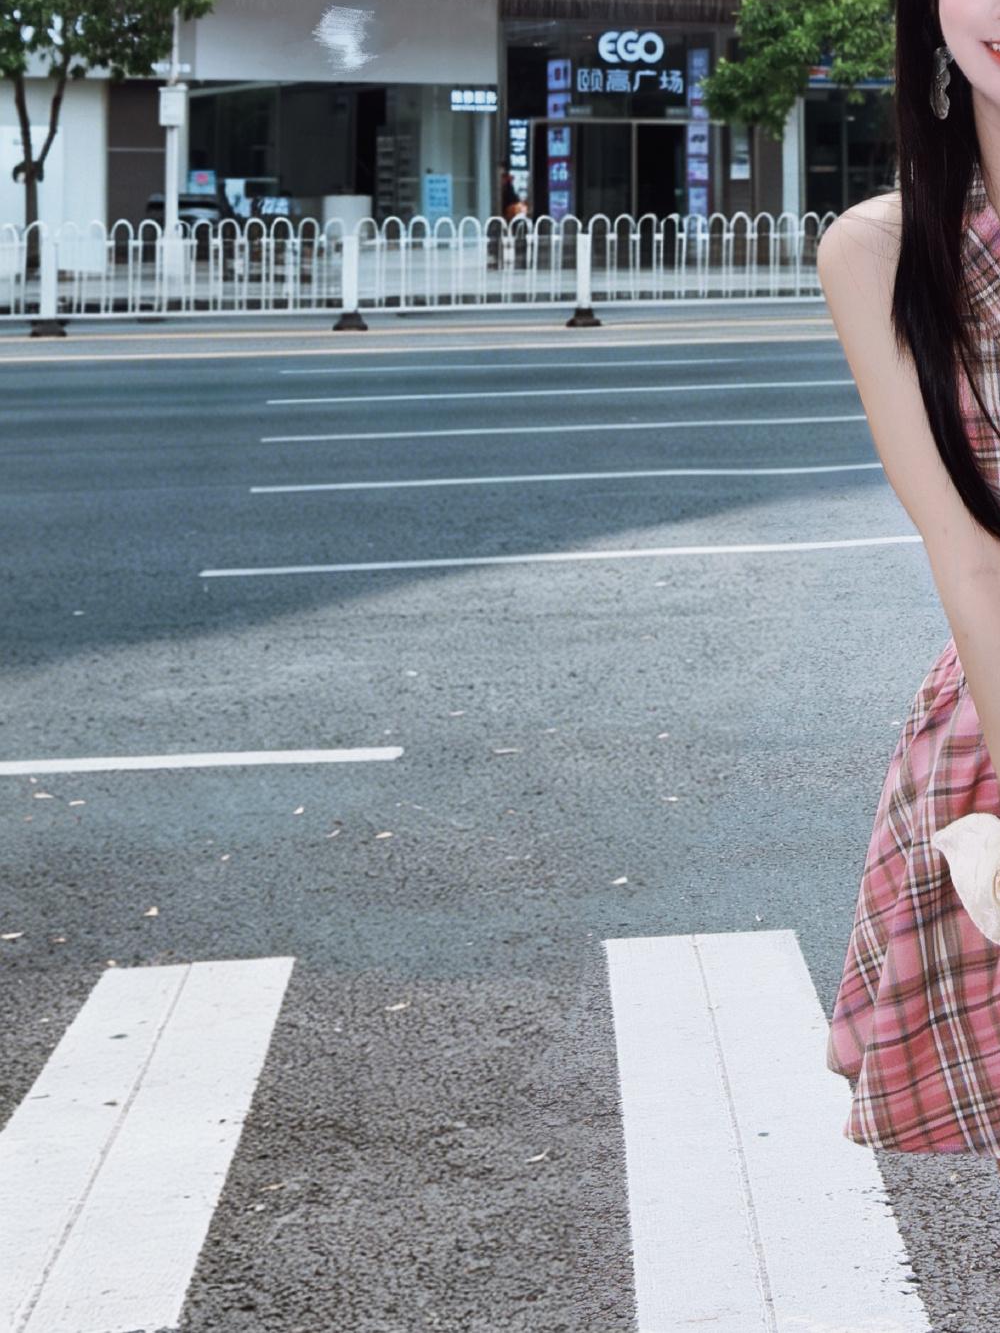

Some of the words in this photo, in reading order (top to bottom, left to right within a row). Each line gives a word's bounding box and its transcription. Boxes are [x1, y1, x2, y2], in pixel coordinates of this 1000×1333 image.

[598, 30, 664, 63] EGO
[577, 68, 684, 94] 颐高广场
